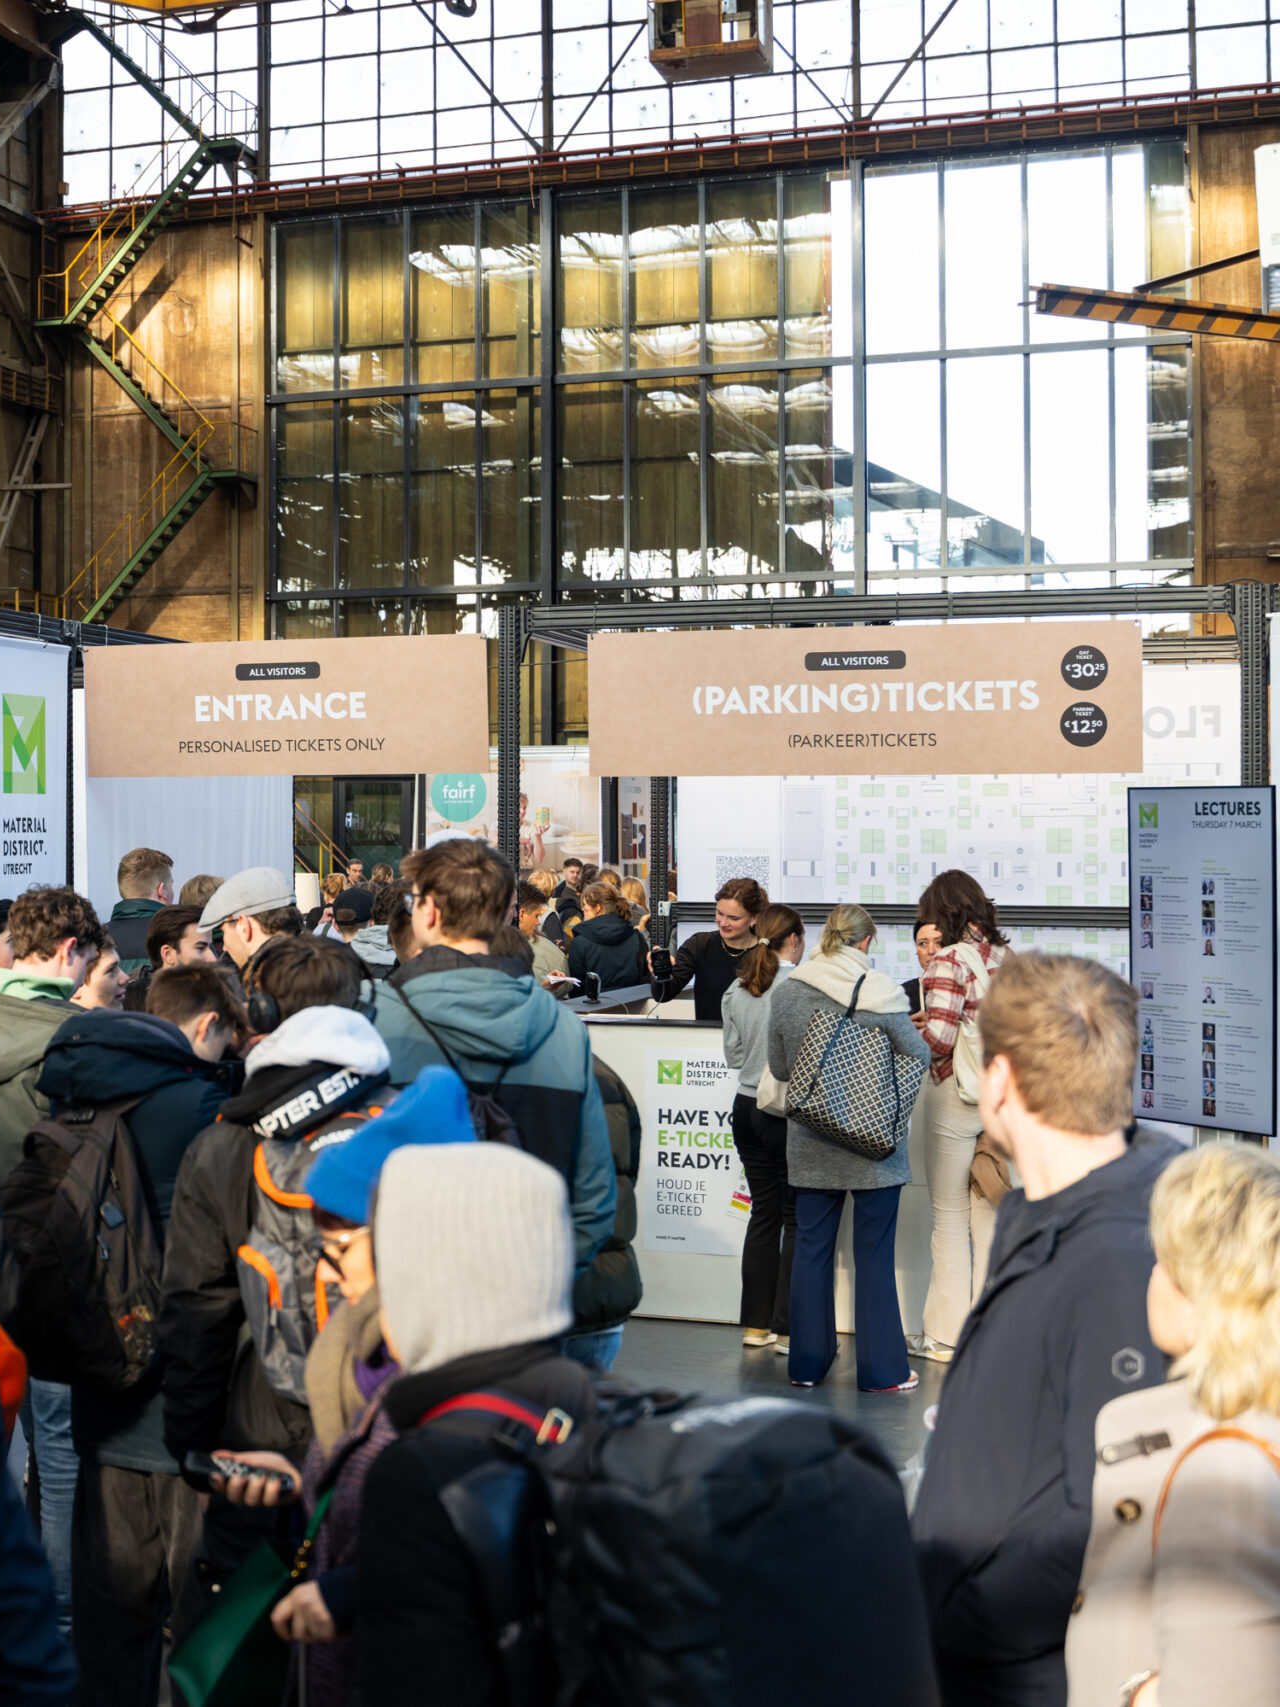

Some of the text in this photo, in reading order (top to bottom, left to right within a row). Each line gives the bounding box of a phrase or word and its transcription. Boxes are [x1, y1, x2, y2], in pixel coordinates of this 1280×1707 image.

[821, 656, 889, 666] ALL VISITORS
[249, 667, 306, 677] ALL VISITORS
[692, 679, 1040, 715] (PARKING)TICKETS
[194, 691, 367, 722] ENTRANCE
[179, 738, 386, 753] PERSONALISED TICKETS ONLY
[788, 733, 937, 748] (PARKEER)TICKETS
[442, 781, 476, 800] fairf
[1195, 801, 1262, 816] LECTURES
[3, 817, 47, 833] MATERIAL
[1192, 820, 1262, 829] THURSDAY 7 MARCH
[3, 863, 32, 875] UTRECHT
[686, 1060, 729, 1069] MATERIA
[658, 1108, 709, 1126] HAVE
[658, 1130, 734, 1149] E-TICKE
[658, 1151, 730, 1170] READY!
[657, 1179, 706, 1191] HOUD JE
[657, 1192, 706, 1203] E-TICKET
[657, 1204, 702, 1216] GEREED
